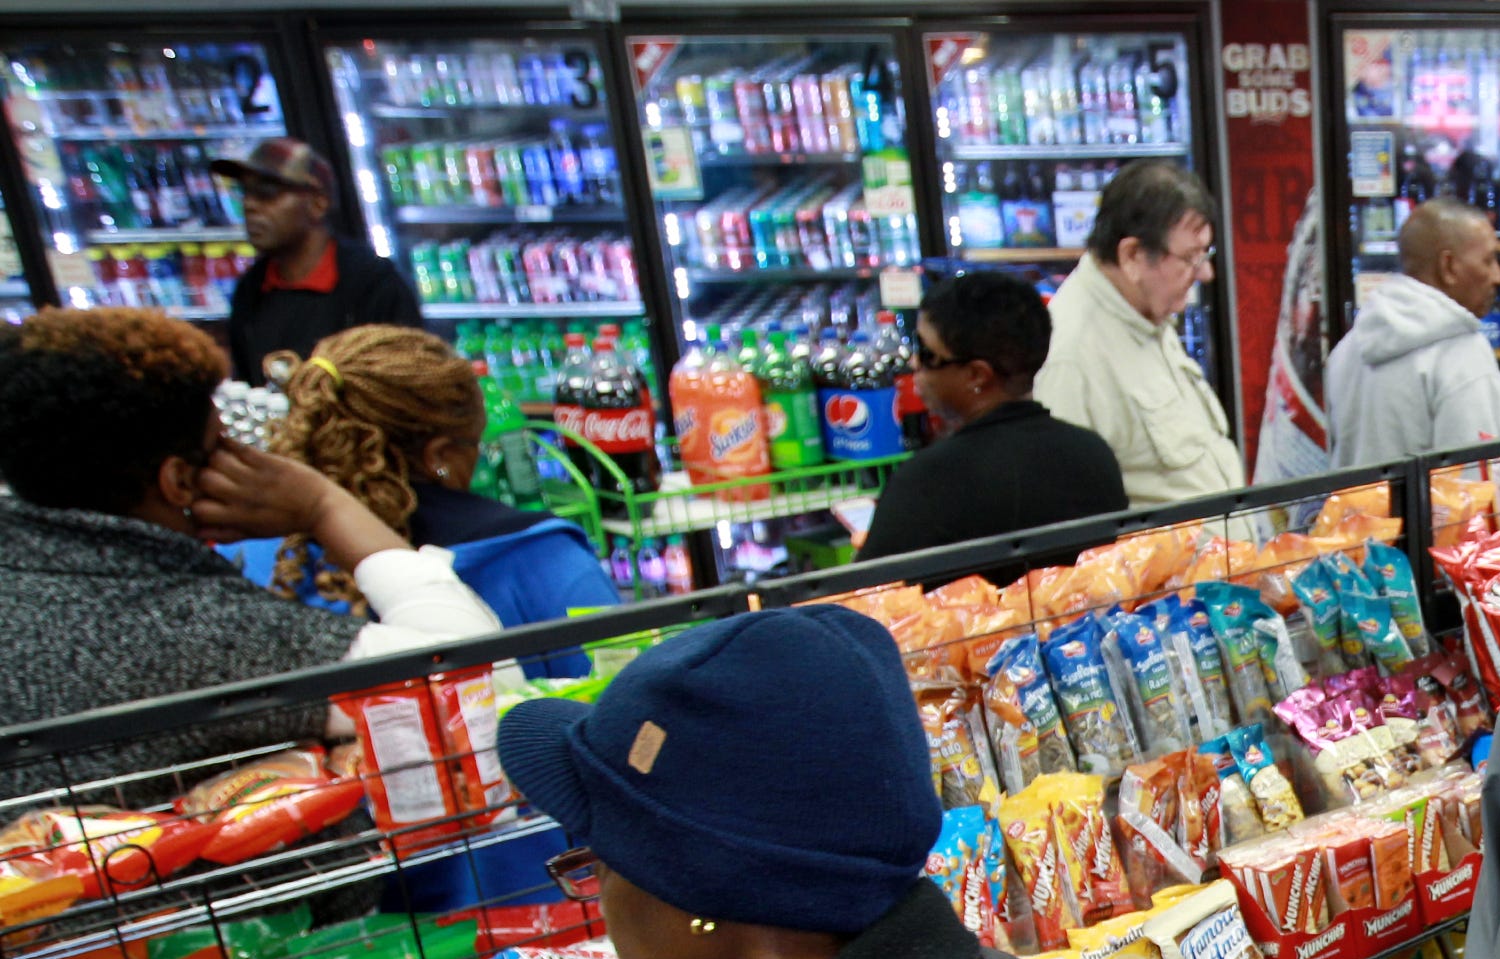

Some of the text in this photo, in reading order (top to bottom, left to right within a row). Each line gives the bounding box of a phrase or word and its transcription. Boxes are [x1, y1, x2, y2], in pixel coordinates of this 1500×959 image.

[863, 46, 890, 93] 4
[1146, 39, 1178, 97] 5
[1222, 43, 1310, 72] GRAB
[229, 55, 271, 114] 2
[566, 50, 598, 108] 3
[1239, 71, 1295, 89] SOME
[1226, 88, 1312, 118] BUDS
[1426, 864, 1474, 901] MUNCHIES
[1362, 899, 1414, 937] MUNCHIES
